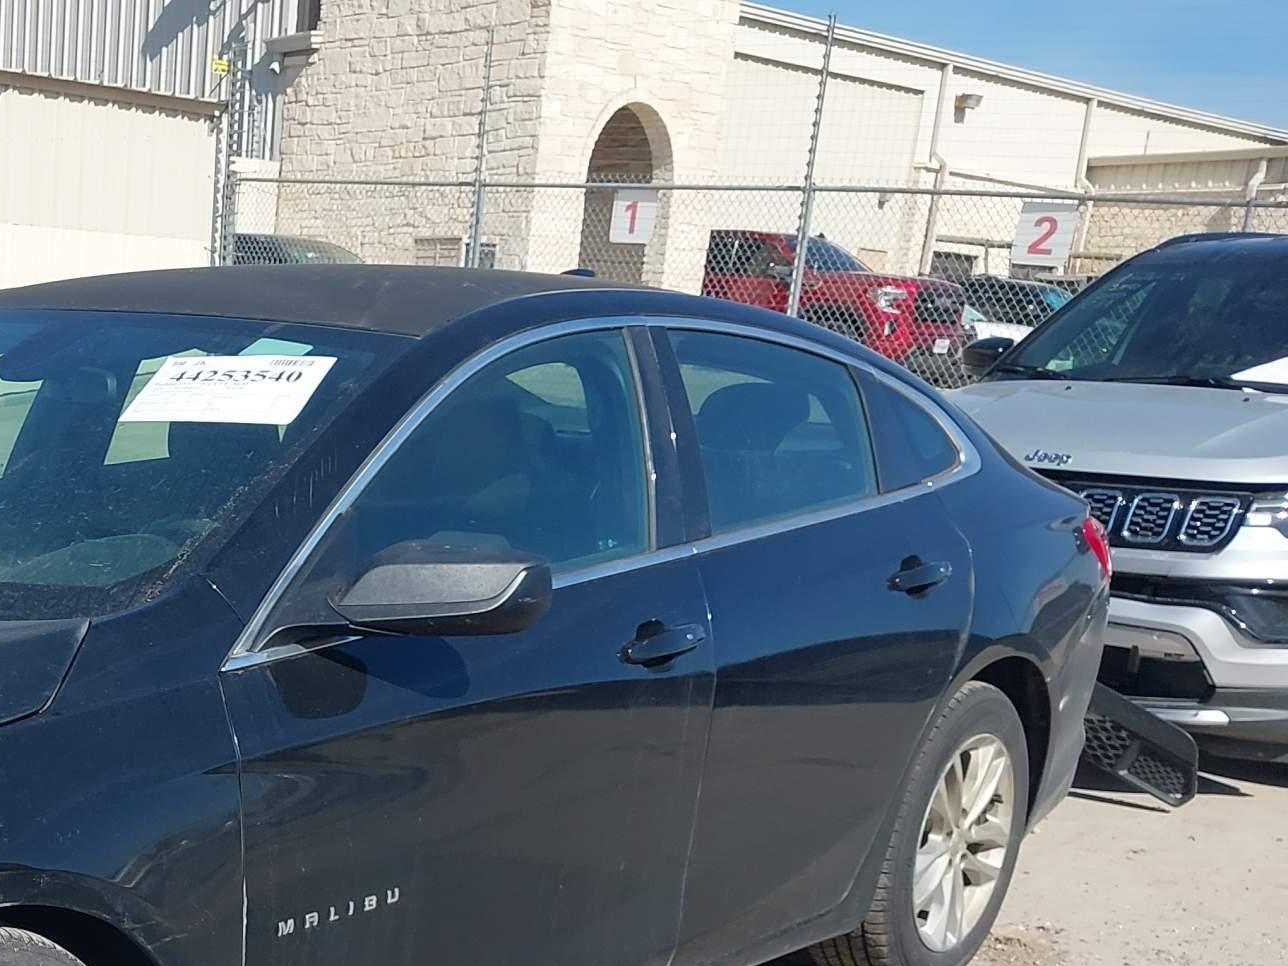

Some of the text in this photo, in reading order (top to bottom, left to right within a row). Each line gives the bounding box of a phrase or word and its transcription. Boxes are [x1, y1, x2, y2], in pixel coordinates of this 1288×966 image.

[624, 200, 639, 234] 1
[1026, 215, 1059, 256] 2
[169, 370, 304, 383] 44253540
[1024, 449, 1072, 465] Jeep
[277, 887, 400, 937] MALIBU
